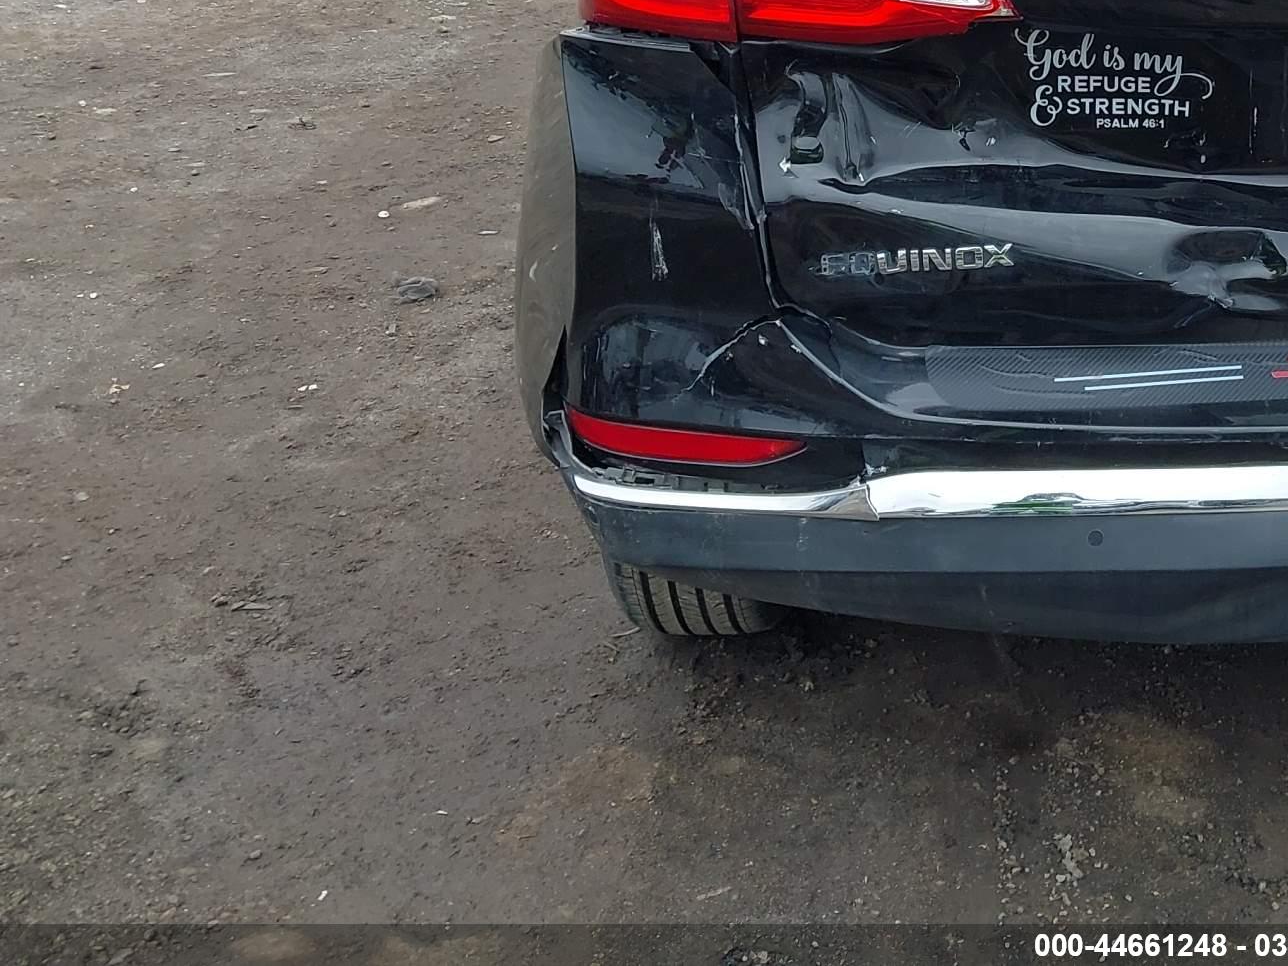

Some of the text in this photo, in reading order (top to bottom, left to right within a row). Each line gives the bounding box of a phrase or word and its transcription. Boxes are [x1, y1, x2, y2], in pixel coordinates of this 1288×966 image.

[1014, 27, 1216, 100] God is my
[1057, 75, 1151, 93] REFUGE
[1066, 97, 1190, 117] STRENGTH
[1096, 118, 1165, 129] PSALM 46:1
[820, 243, 1015, 276] EQUINOX
